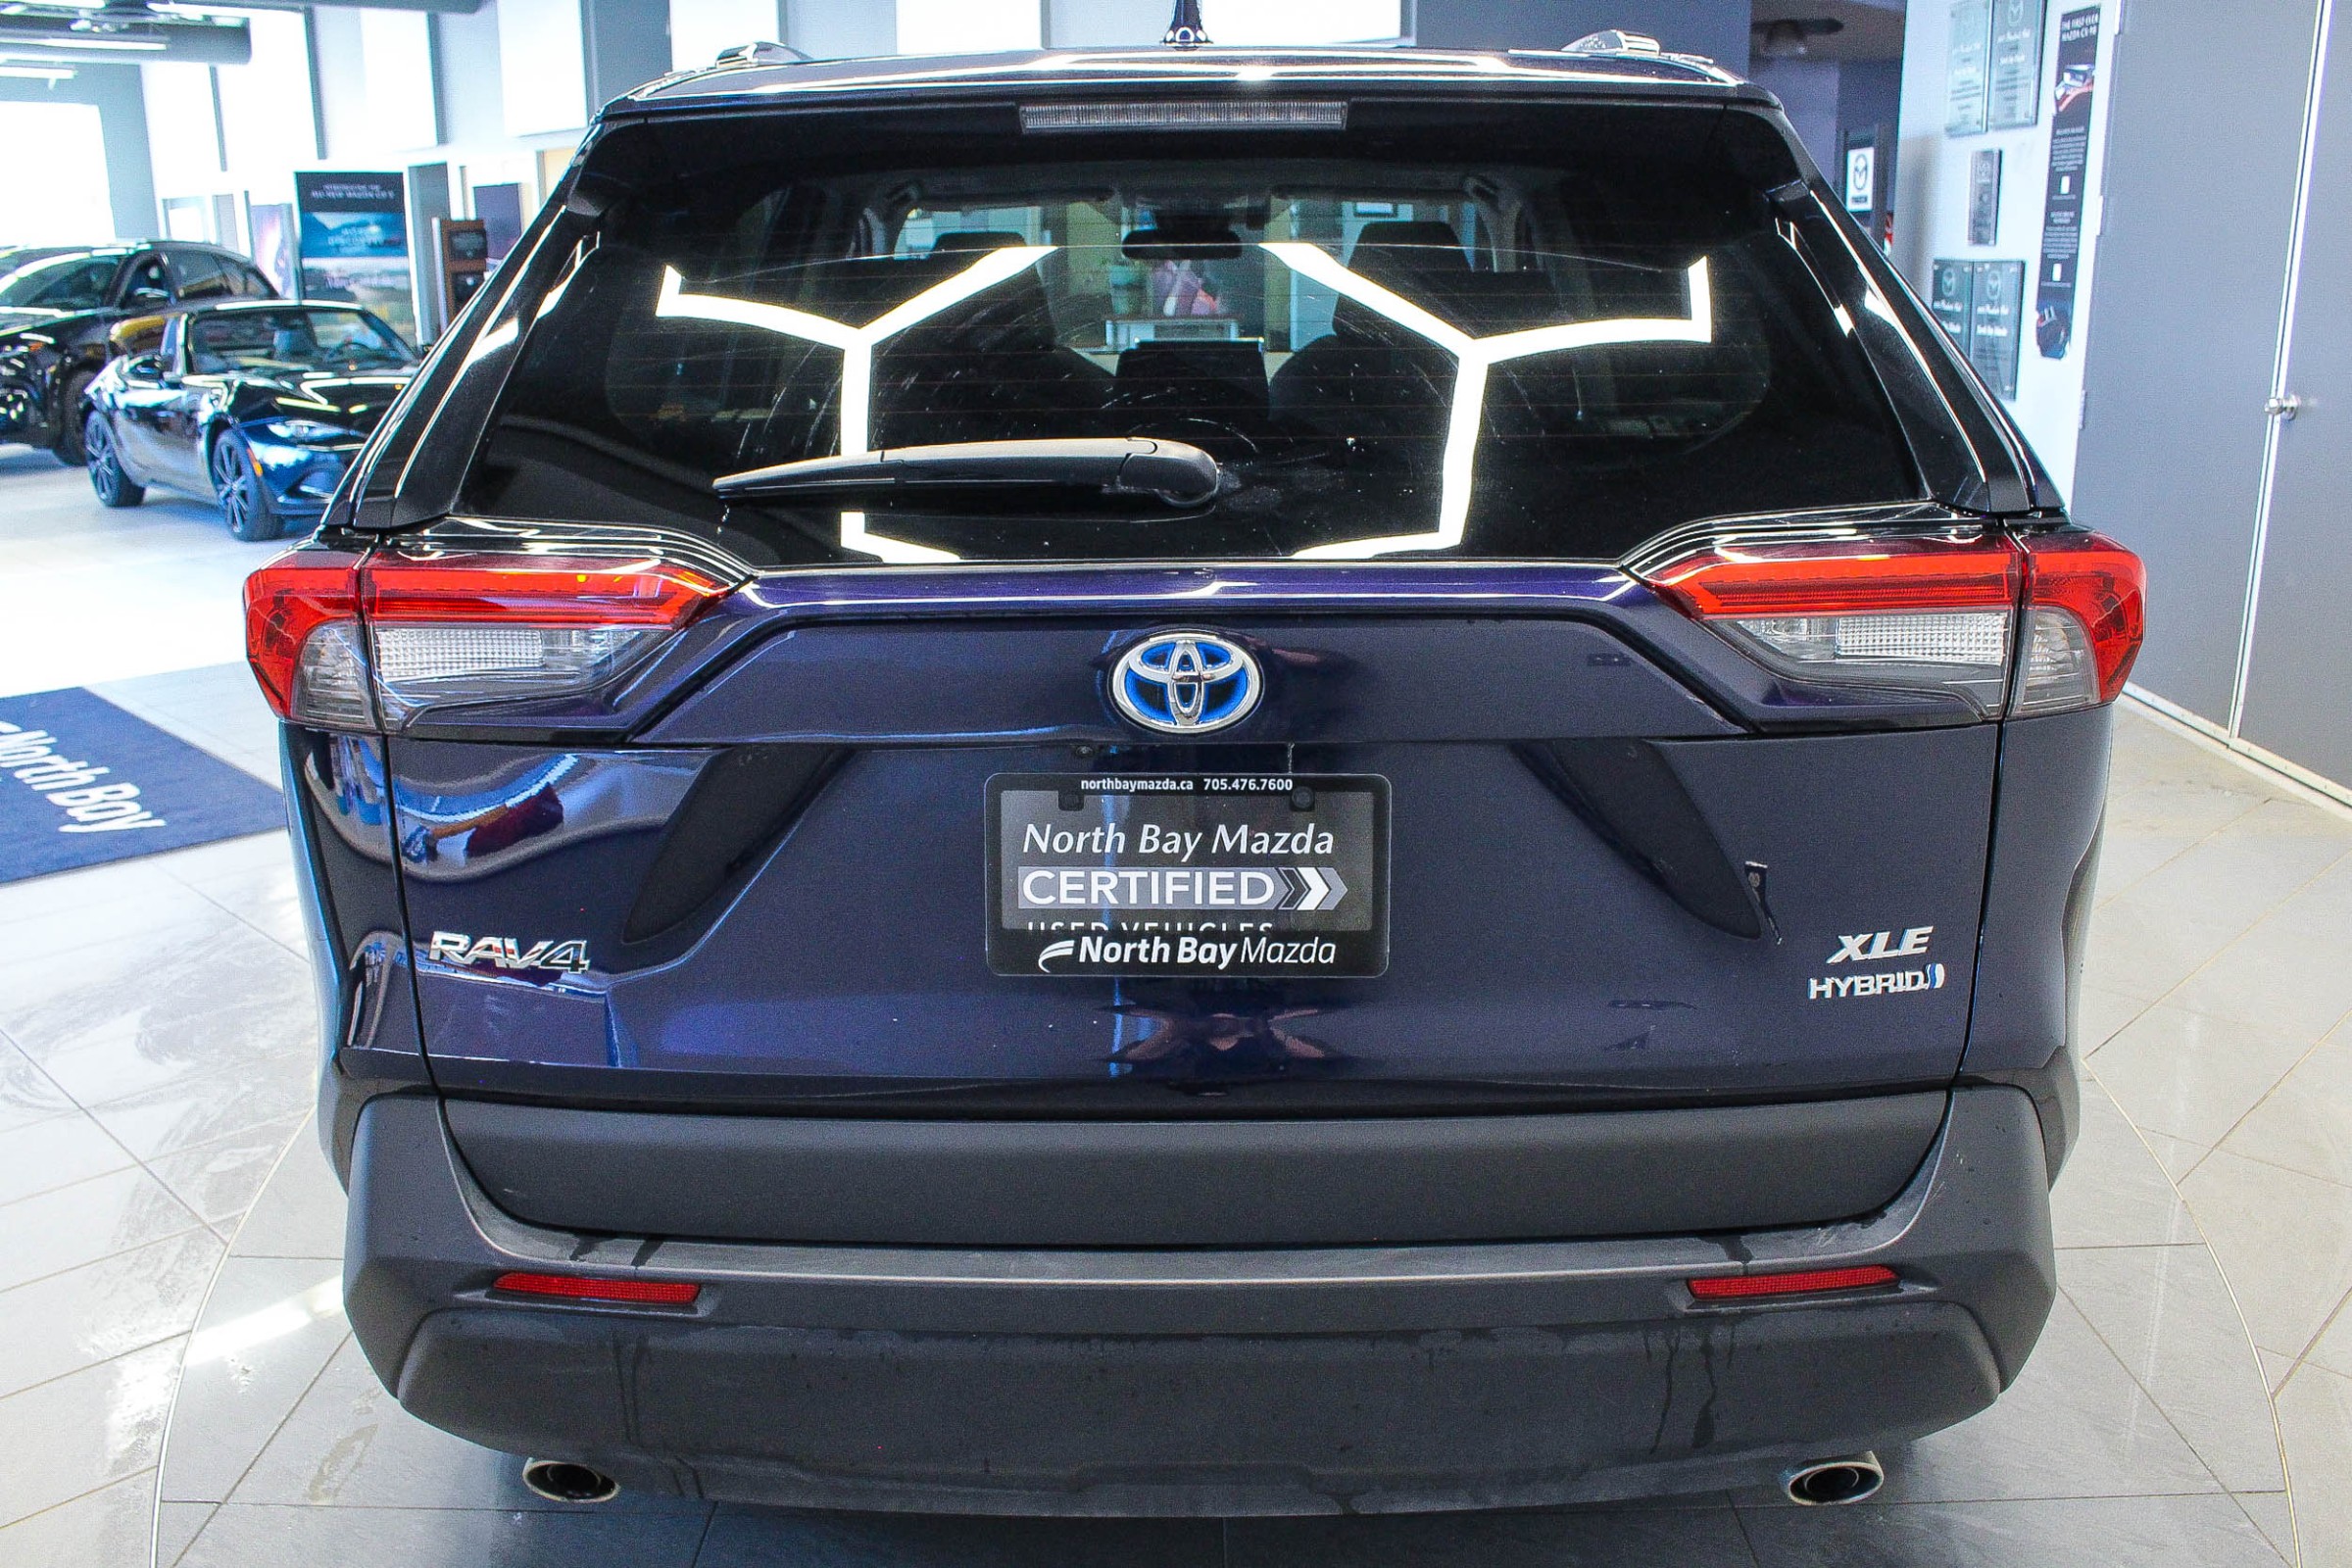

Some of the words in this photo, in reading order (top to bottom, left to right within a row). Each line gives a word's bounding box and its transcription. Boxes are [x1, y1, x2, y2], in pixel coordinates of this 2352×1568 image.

[0, 729, 110, 791] North
[1081, 777, 1194, 792] northbaymazda.ca
[1203, 778, 1294, 791] 705.476.7600
[46, 782, 167, 832] Bay
[1022, 822, 1126, 854] North
[1138, 823, 1202, 862] Bay
[1211, 822, 1334, 855] Mazda
[1022, 870, 1275, 905] CERTIFIED
[428, 931, 590, 974] RAV4
[1079, 936, 1171, 963] North
[1177, 936, 1238, 970] Bay
[1240, 936, 1337, 964] Mazda
[1826, 925, 1934, 963] XLE
[1808, 970, 1928, 999] HYBRID
